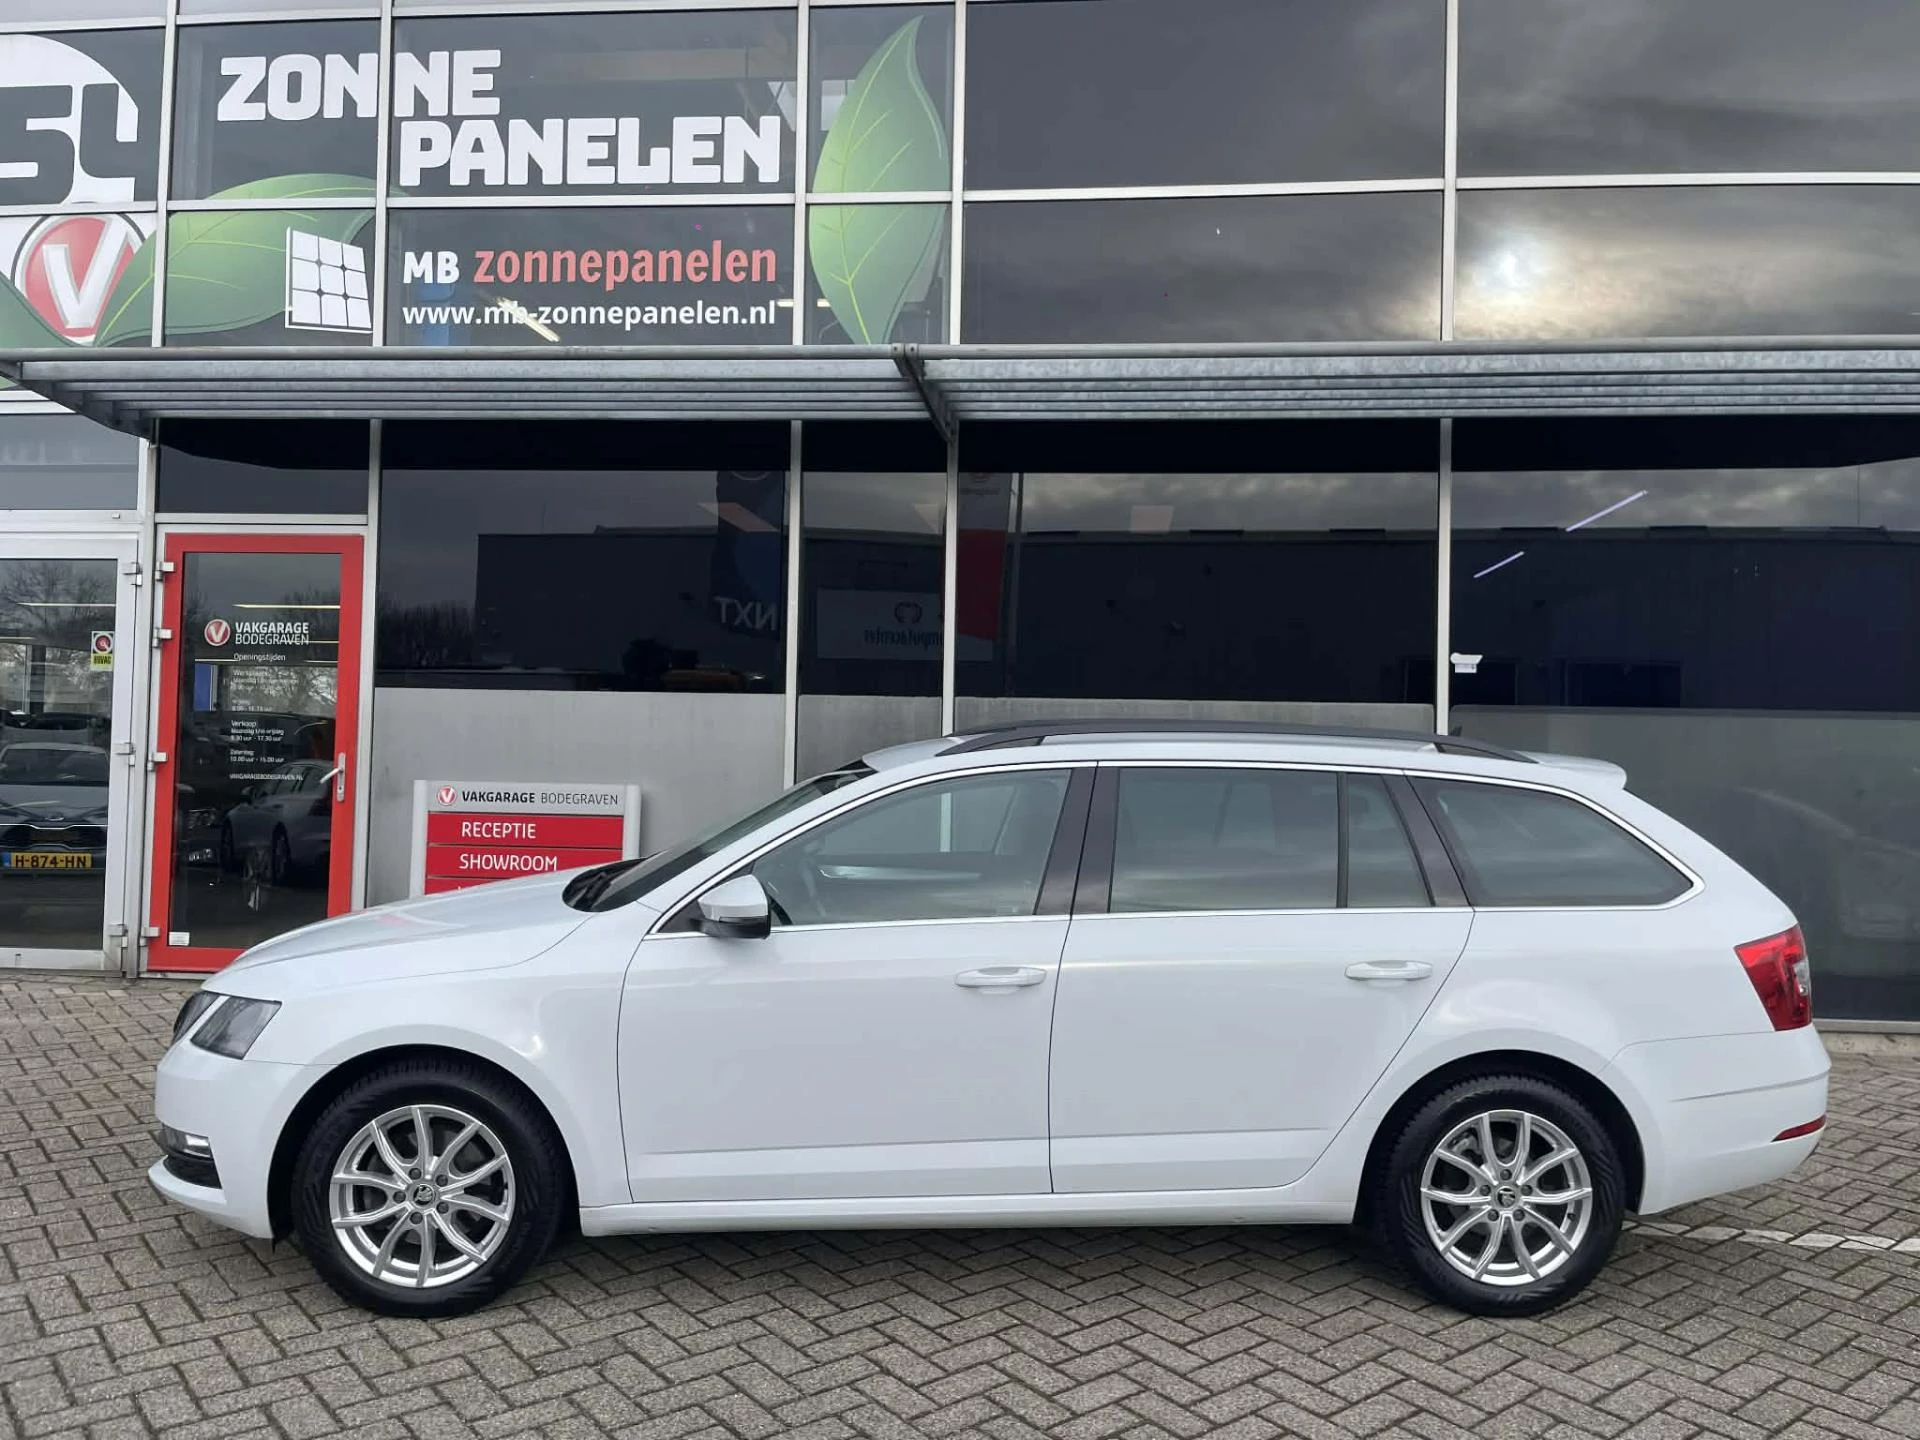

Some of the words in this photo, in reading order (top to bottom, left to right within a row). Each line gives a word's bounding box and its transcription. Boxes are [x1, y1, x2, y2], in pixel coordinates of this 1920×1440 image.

[217, 49, 501, 122] ZONNE
[399, 115, 782, 187] PANELEN
[402, 251, 461, 284] MB
[473, 240, 777, 291] zonnepanelen
[402, 300, 776, 331] www.mb-zonnepanelen.nl
[235, 621, 309, 633] VAKGARAGE
[235, 633, 310, 646] BODEGRAVEN
[233, 652, 286, 662] Openingstijden
[462, 791, 535, 803] VAKGARAGE
[541, 792, 618, 805] BODEGRAVEN
[461, 821, 537, 839] RECEPTIE
[15, 855, 87, 869] H-874-HN
[458, 853, 558, 871] SHOWROOM
